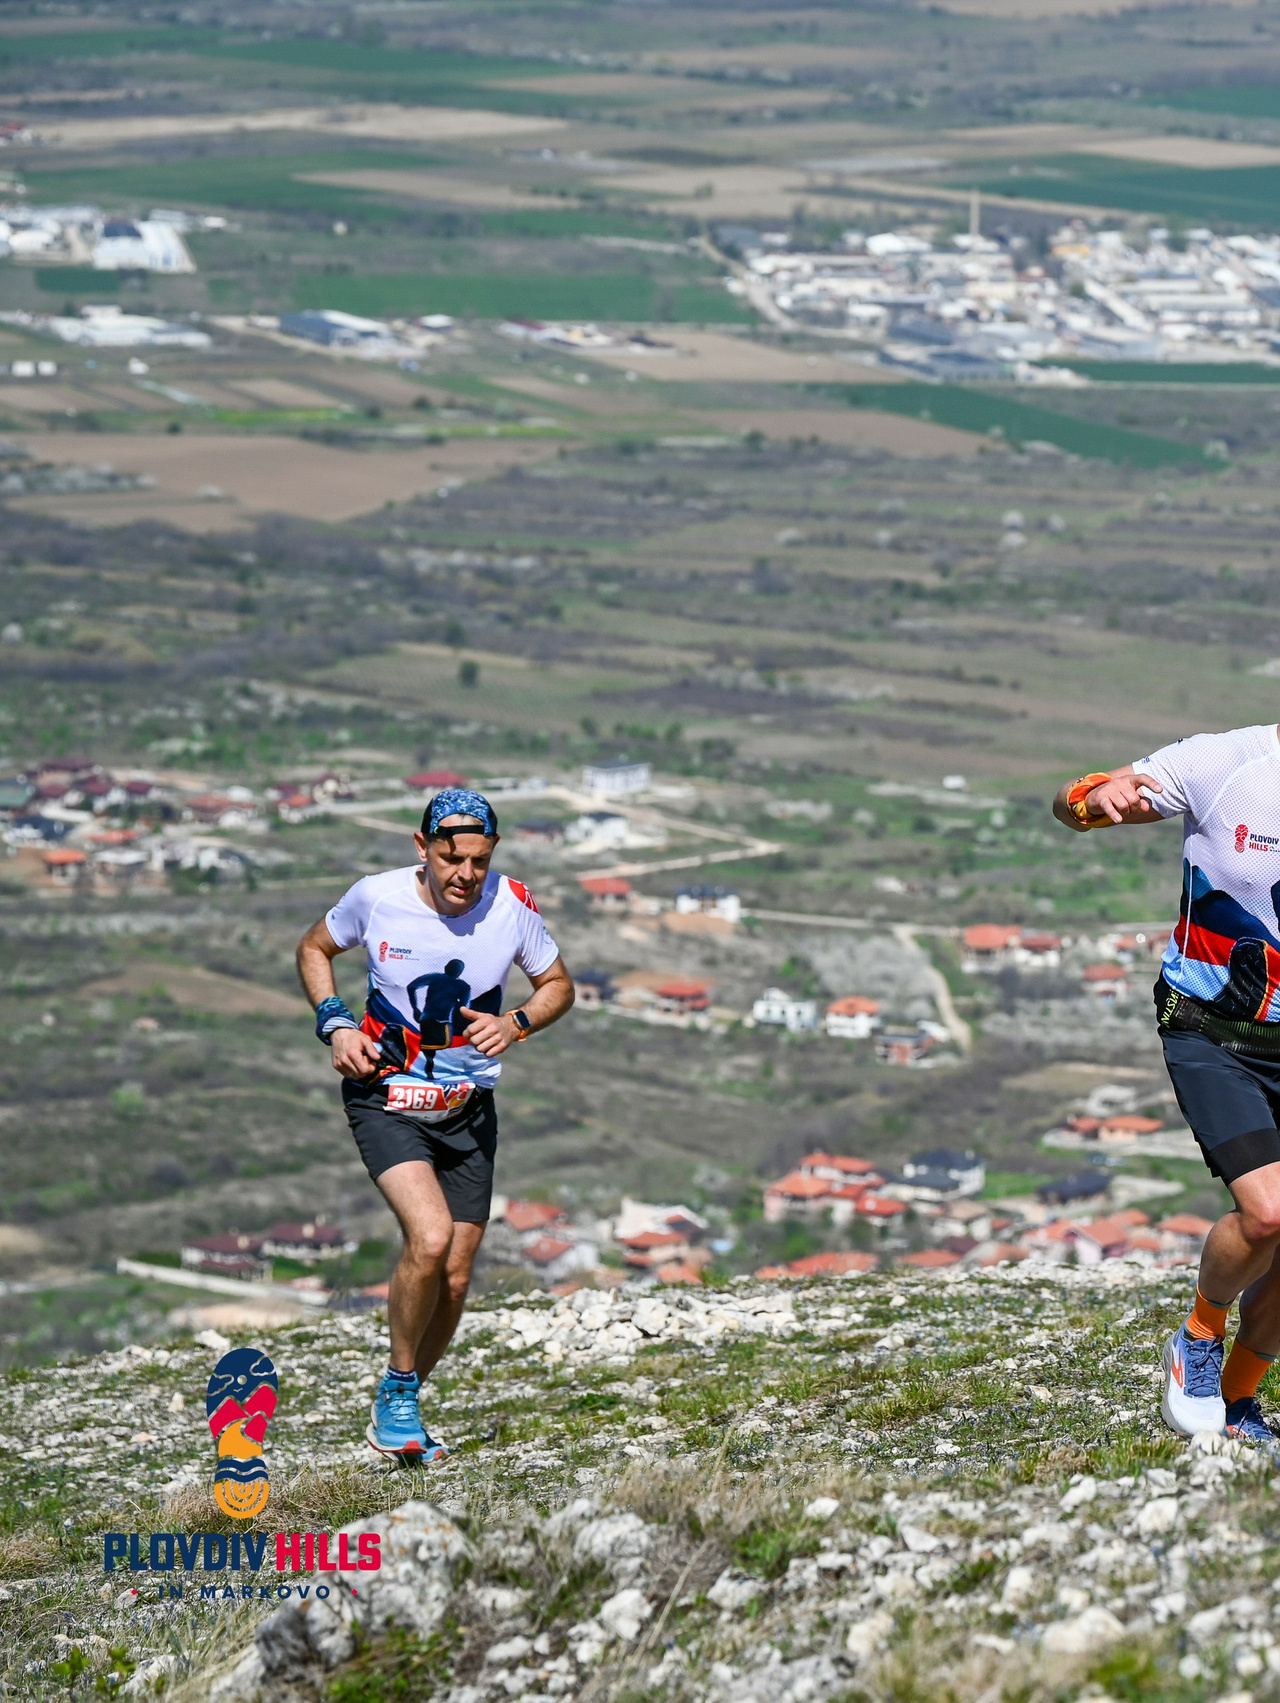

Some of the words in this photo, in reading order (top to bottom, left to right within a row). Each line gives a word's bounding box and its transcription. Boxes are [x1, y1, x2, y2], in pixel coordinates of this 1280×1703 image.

[1250, 834, 1279, 844] PLOVDIV
[1249, 842, 1269, 852] HILLS
[393, 1087, 438, 1109] 2169
